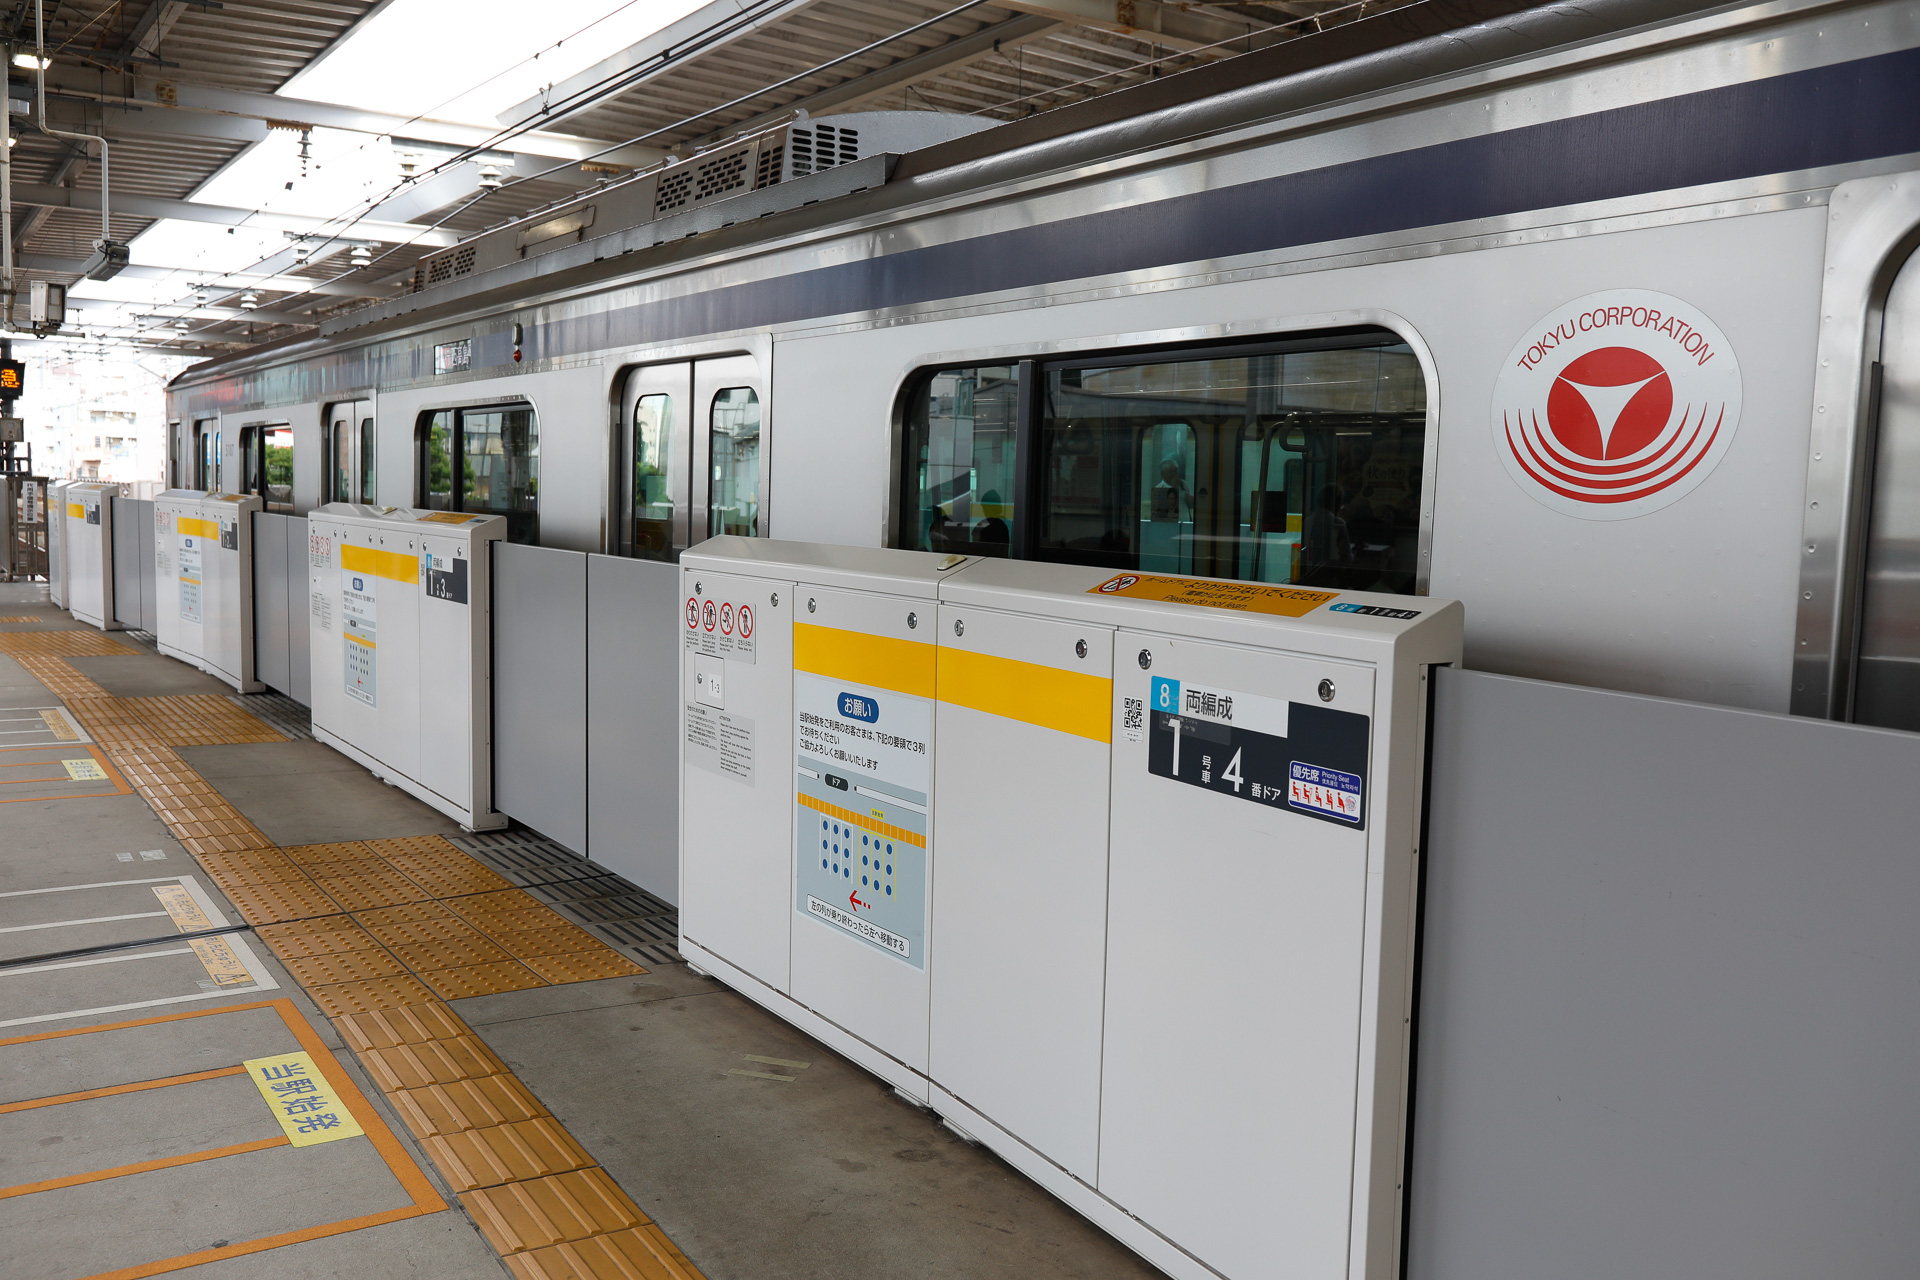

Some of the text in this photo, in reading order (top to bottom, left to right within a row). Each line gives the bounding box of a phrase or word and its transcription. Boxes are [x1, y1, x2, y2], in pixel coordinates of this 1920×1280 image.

[1517, 306, 1715, 371] TOKYU CORPORATION
[429, 571, 434, 596] 1
[441, 578, 446, 598] 3
[1161, 594, 1195, 604] Please
[844, 697, 872, 717] お願い
[1159, 683, 1233, 721] 8 両編成
[799, 711, 926, 755] 当駅始発をご利用のお客さまは、下記の要領で3列
[799, 725, 840, 745] でお待ちください
[799, 738, 879, 770] ご協力よろしくお願いいたします
[1168, 718, 1181, 777] 1
[1201, 755, 1212, 784] 号車
[1221, 746, 1244, 793] 4
[1251, 782, 1281, 801] 番ドア
[832, 777, 841, 787] ドア
[1292, 764, 1320, 783] 優先席
[1321, 771, 1350, 783] Priority Seat
[810, 900, 905, 952] 左の列が乗り終わったら左へ移動する
[260, 1062, 342, 1134] 当駅始発
